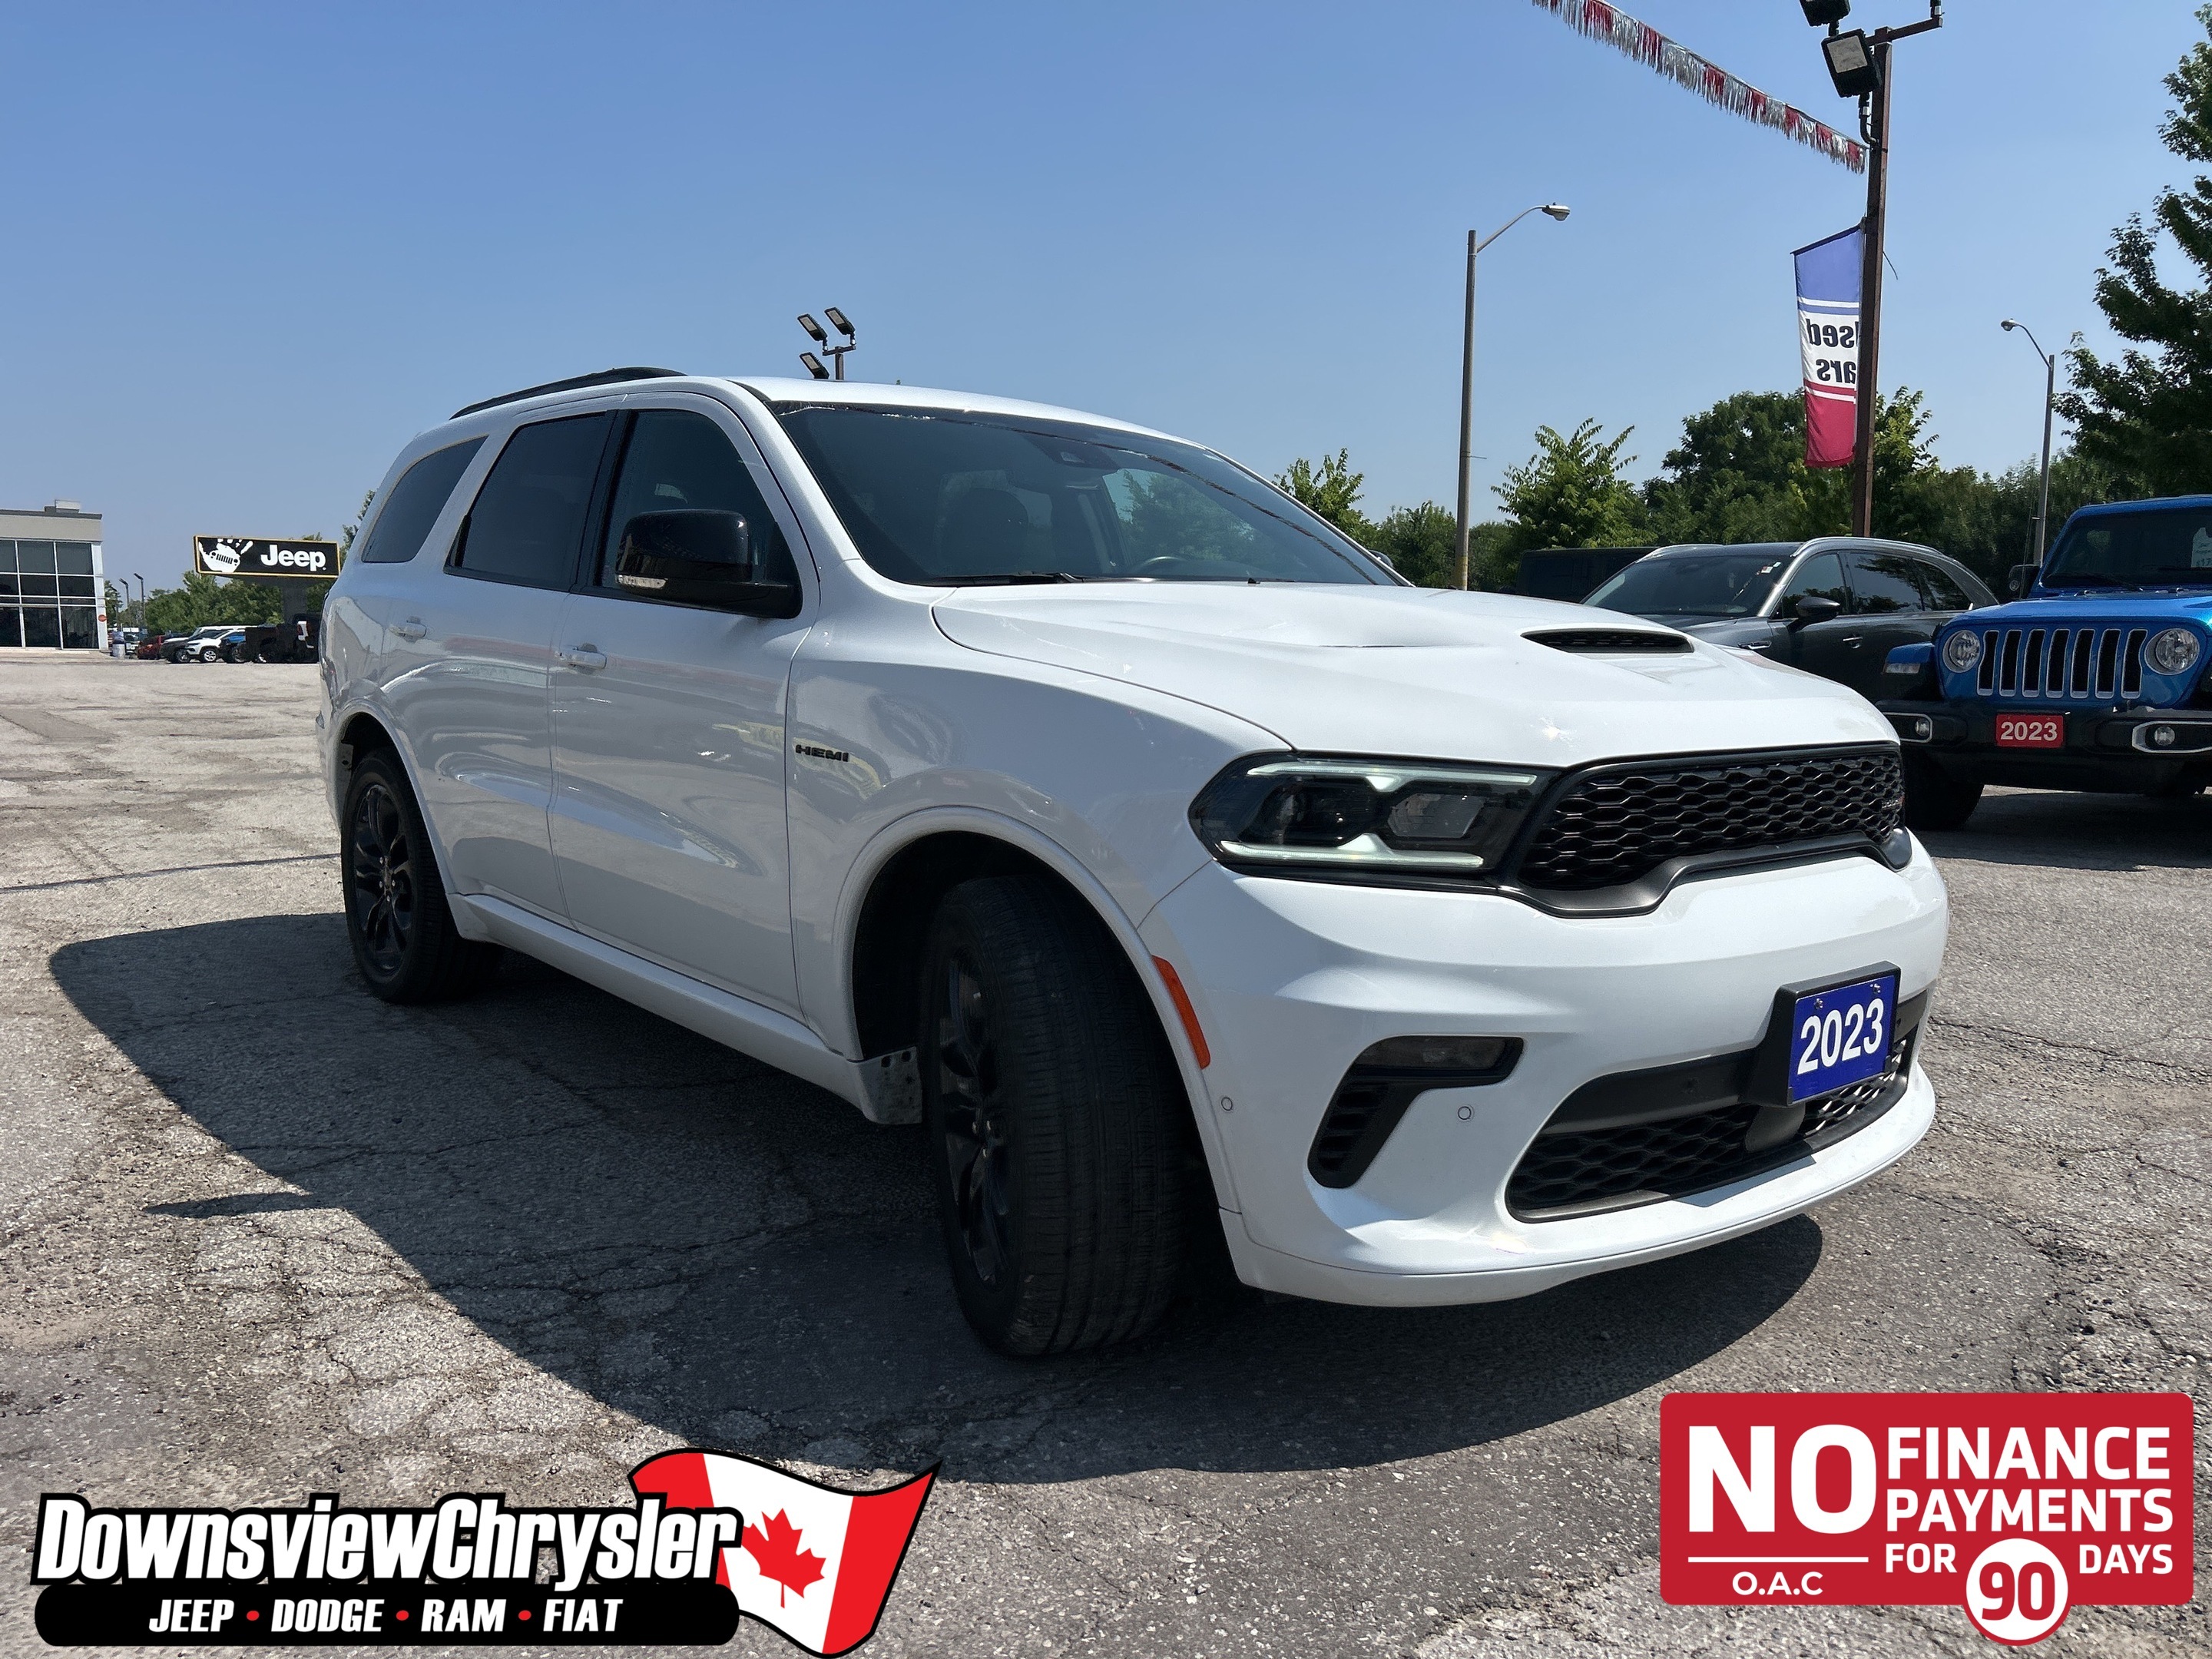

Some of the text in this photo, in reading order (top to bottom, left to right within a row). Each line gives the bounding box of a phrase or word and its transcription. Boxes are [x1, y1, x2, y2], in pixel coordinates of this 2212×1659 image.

[260, 545, 326, 572] Jeep
[2000, 721, 2058, 741] 2023
[795, 744, 849, 762] HEMI
[1797, 998, 1884, 1075] 2023
